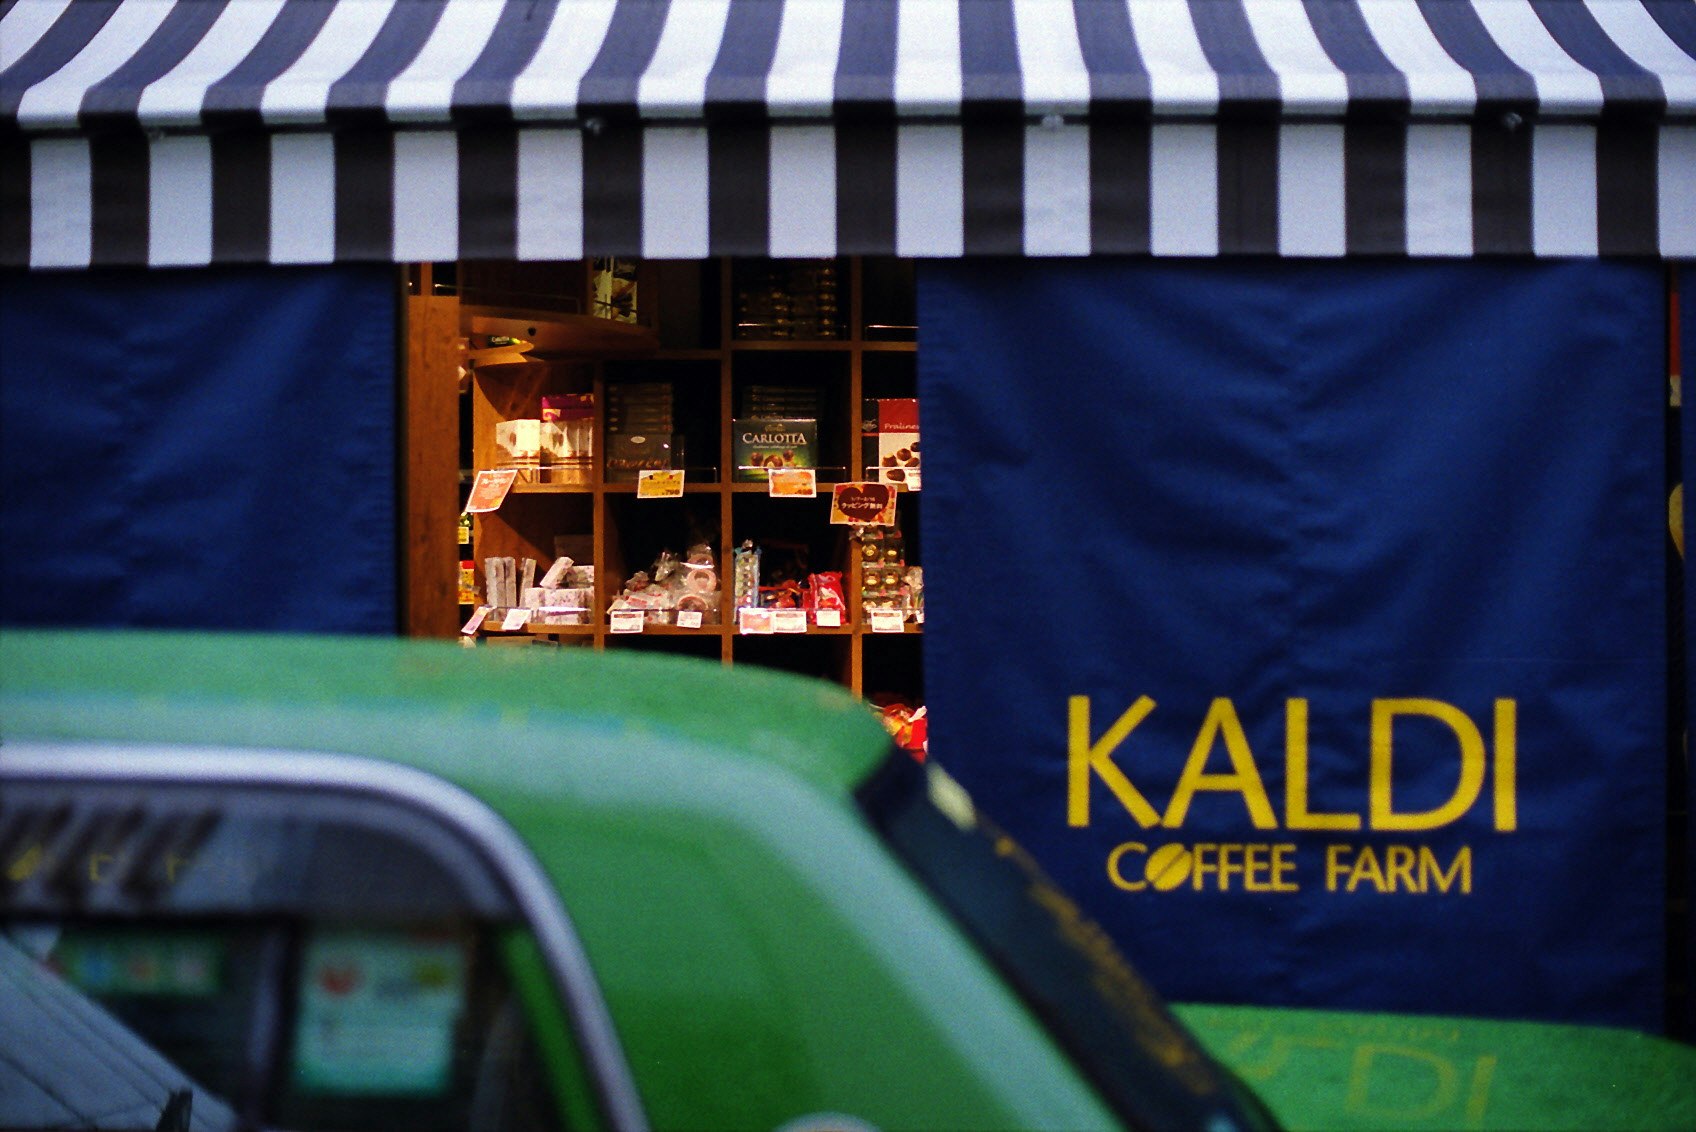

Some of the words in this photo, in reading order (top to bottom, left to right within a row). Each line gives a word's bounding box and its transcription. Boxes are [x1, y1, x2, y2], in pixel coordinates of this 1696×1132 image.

[742, 432, 808, 446] CARLOTTA
[1067, 694, 1518, 832] KALDI
[1107, 841, 1300, 893] COFFEE
[1325, 843, 1472, 894] FARM
